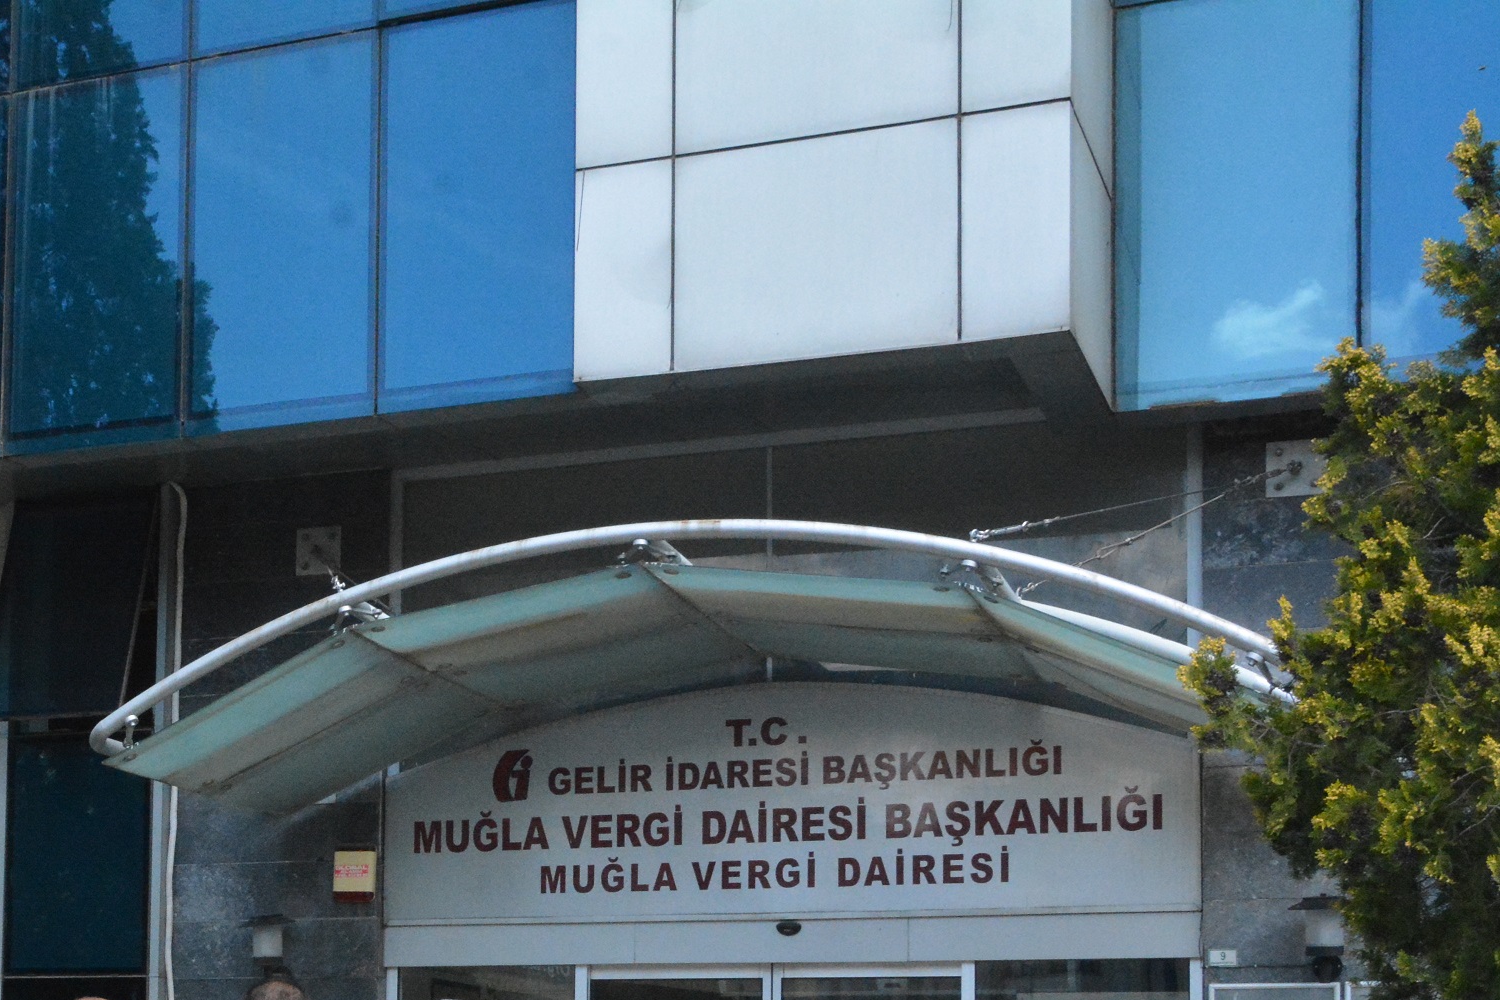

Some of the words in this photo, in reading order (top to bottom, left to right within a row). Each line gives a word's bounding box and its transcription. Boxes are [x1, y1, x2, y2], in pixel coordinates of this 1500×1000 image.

[548, 758, 653, 796] GELİR
[665, 750, 809, 792] İDARESİ
[823, 738, 1062, 790] BAŞKANLIĞI
[413, 810, 550, 854] MUĞLA
[562, 804, 683, 849] VERGİ
[702, 796, 867, 845] DAİRESİ
[885, 785, 1163, 846] BAŞKANLIĞI
[540, 856, 677, 894] MUĞLA
[692, 850, 816, 890] VERGİ
[838, 845, 1010, 888] DAİRESİ
[1220, 951, 1226, 961] 9
